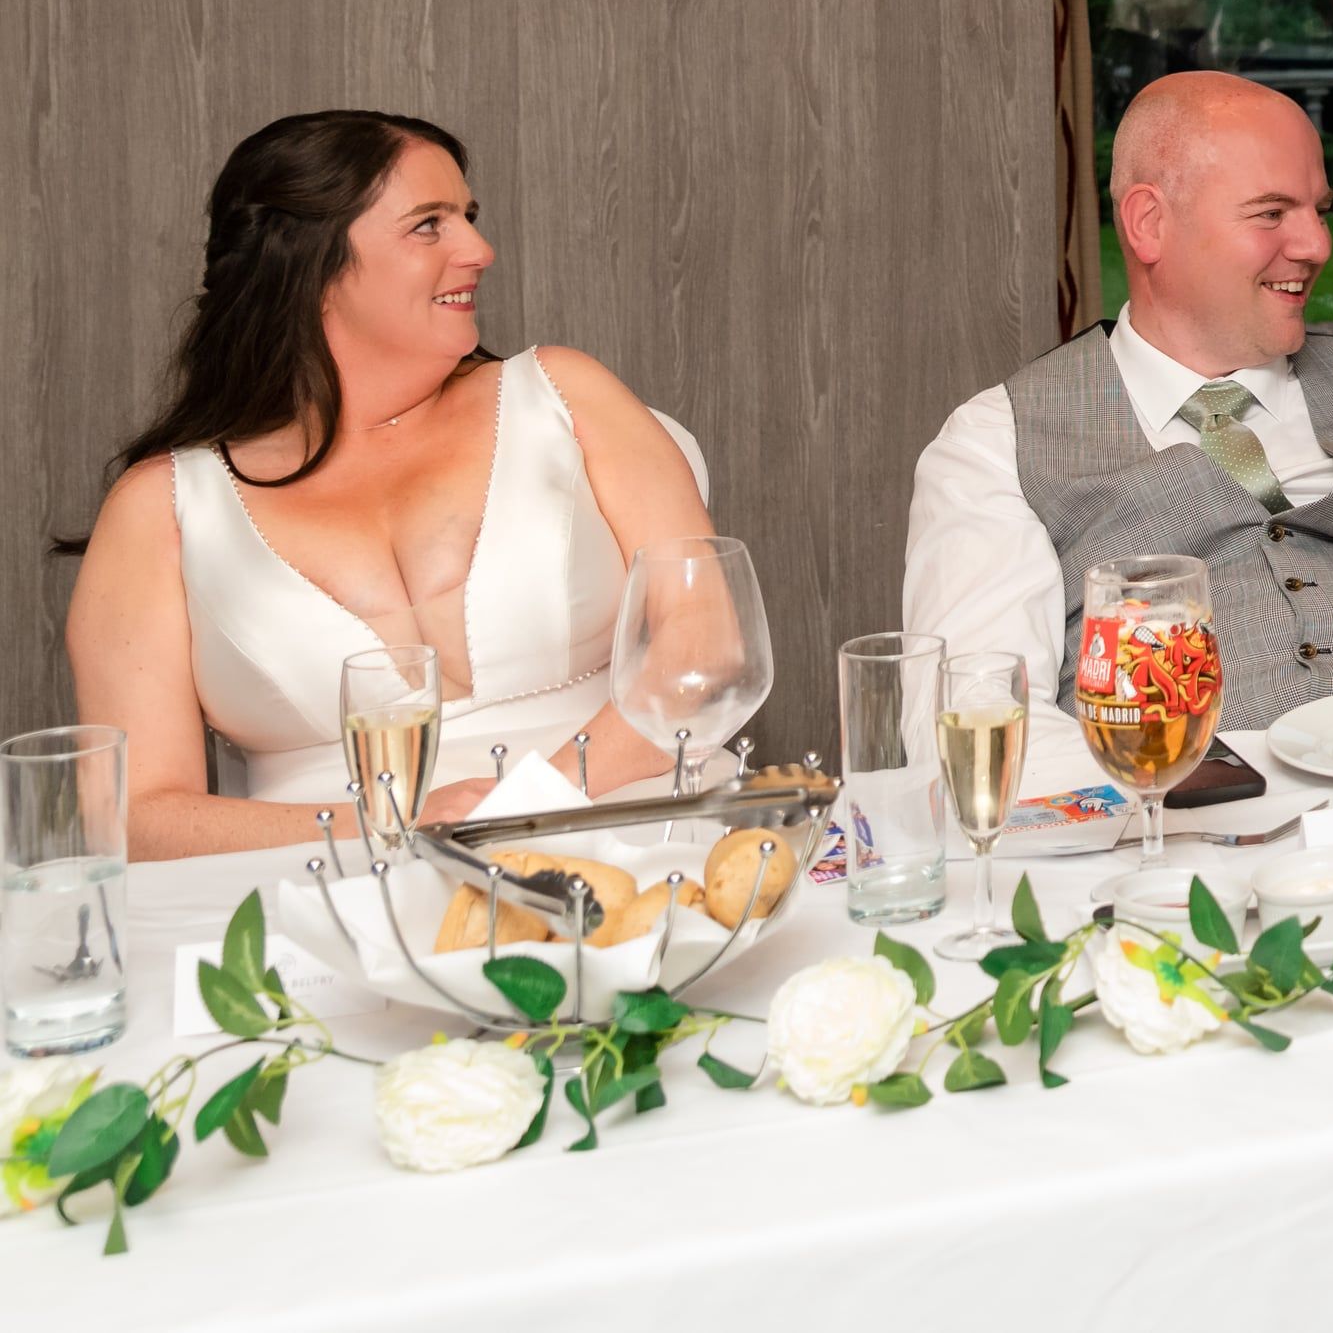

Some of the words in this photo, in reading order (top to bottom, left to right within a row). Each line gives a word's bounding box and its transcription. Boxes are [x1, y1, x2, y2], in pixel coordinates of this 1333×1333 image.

[1088, 703, 1098, 721] DE
[1101, 705, 1141, 724] MADRID
[291, 974, 336, 989] BELFRY
